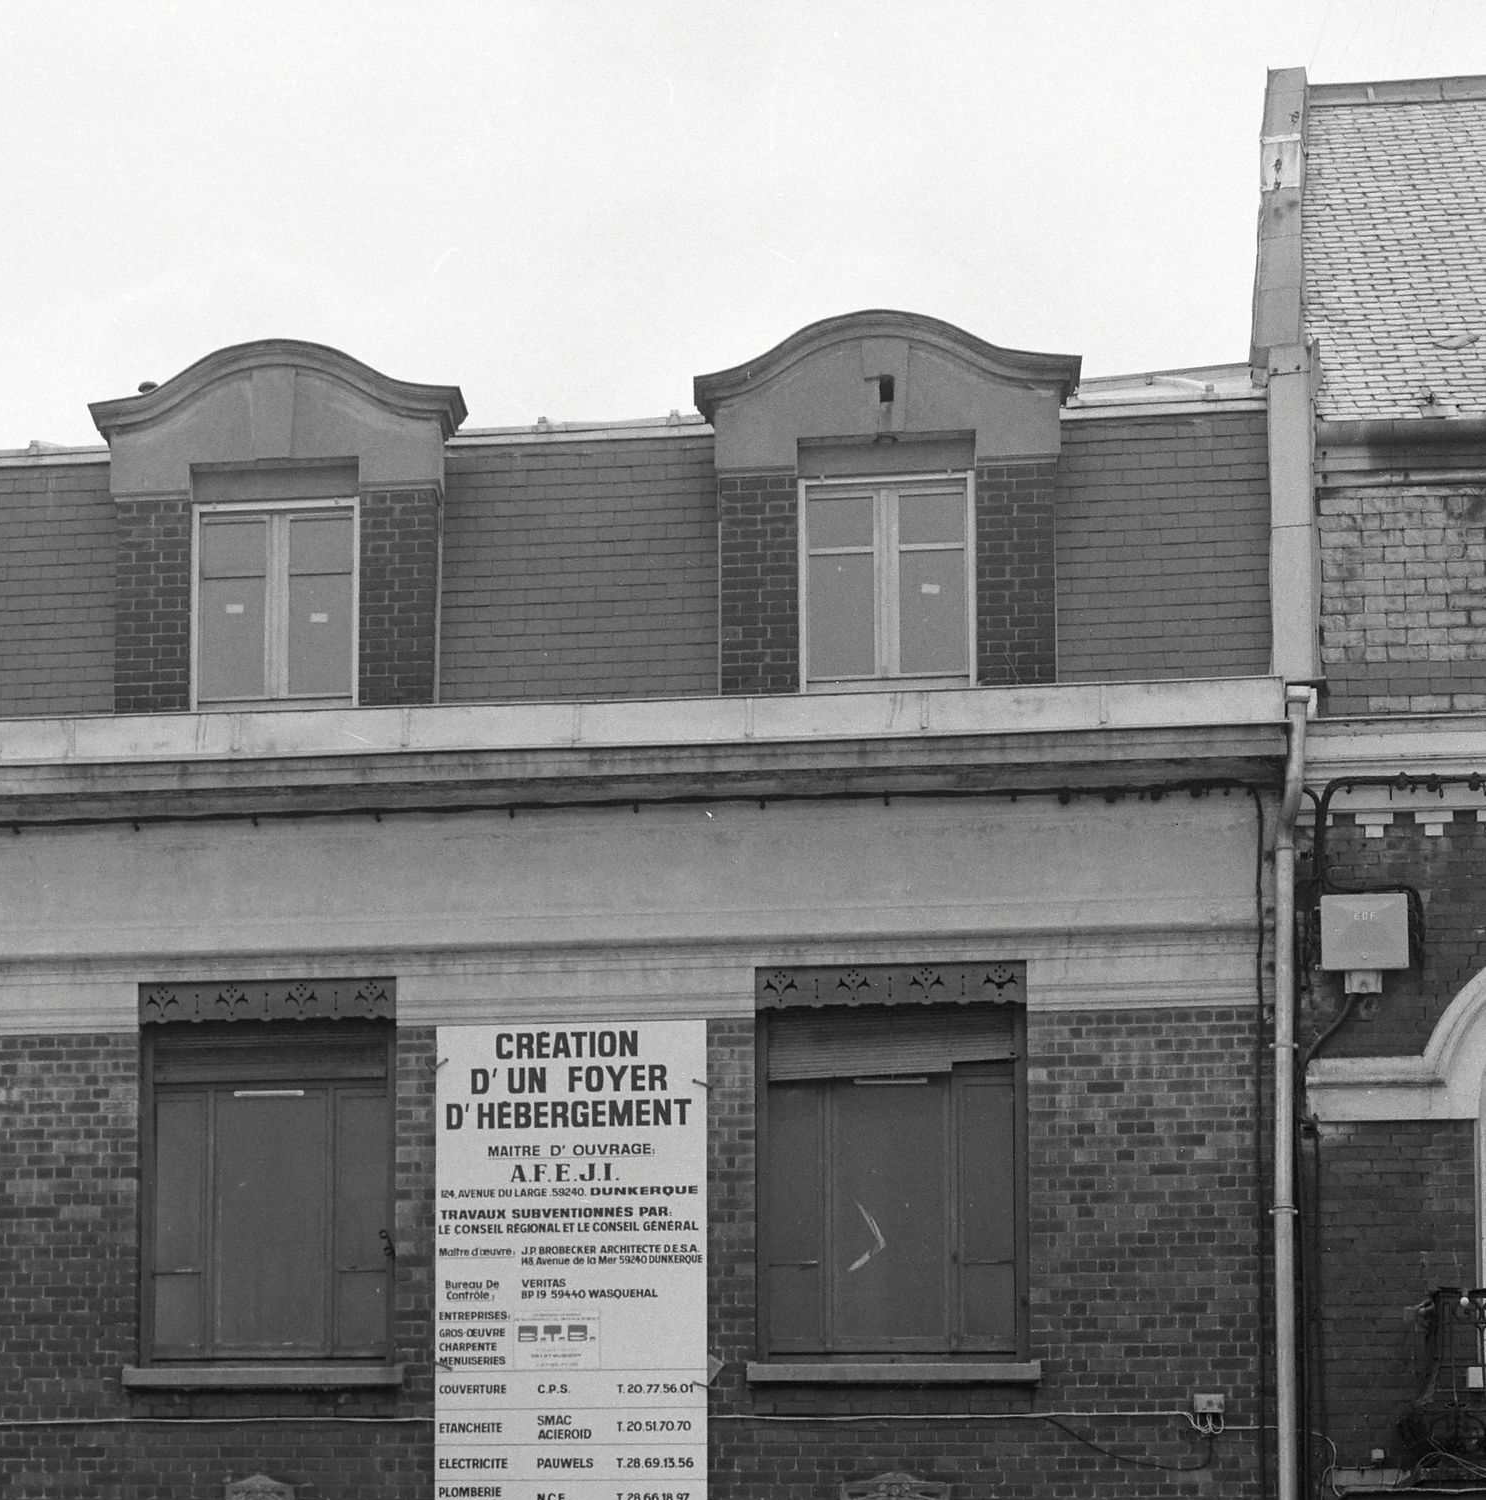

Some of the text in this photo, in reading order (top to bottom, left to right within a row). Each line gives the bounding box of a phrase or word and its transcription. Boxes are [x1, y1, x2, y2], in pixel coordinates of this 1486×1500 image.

[1353, 911, 1377, 921] EDF
[568, 1064, 667, 1093] FOYER
[458, 1189, 495, 1198] AVENUE
[498, 1189, 512, 1197] DU
[514, 1188, 547, 1197] LARGE
[590, 1185, 698, 1196] DUNKERQUE
[440, 1209, 506, 1220] TRAVAUX
[438, 1224, 450, 1235] LE
[454, 1224, 503, 1234] CONSEIL
[563, 1223, 575, 1232] ET
[577, 1222, 590, 1232] LE
[592, 1221, 639, 1232] CONSEIL
[539, 1245, 596, 1255] BROBECKER
[600, 1244, 661, 1254] ARCHITECTE
[536, 1257, 570, 1265] Avenue
[573, 1257, 584, 1265] de
[587, 1256, 596, 1264] la
[598, 1256, 617, 1264] Mer
[619, 1255, 647, 1264] 59240
[649, 1255, 703, 1264] DUNKERQUE
[445, 1280, 499, 1290] Bureau De
[521, 1278, 566, 1288] VERITAS
[521, 1289, 658, 1299] BP 19 59440 WASQUEHAL
[439, 1342, 497, 1352] CHARPENTE
[438, 1356, 506, 1366] MENUISERIES
[439, 1384, 506, 1394] COUVERTURE
[538, 1384, 570, 1394] C.P.S.
[537, 1415, 572, 1426] SMAC
[439, 1422, 502, 1433] ETANCHEITE
[538, 1429, 592, 1440] ACIEROID
[439, 1458, 508, 1469] ELECTRICITE
[537, 1458, 594, 1469] PAUWELS
[439, 1486, 502, 1498] PLOMBERIE
